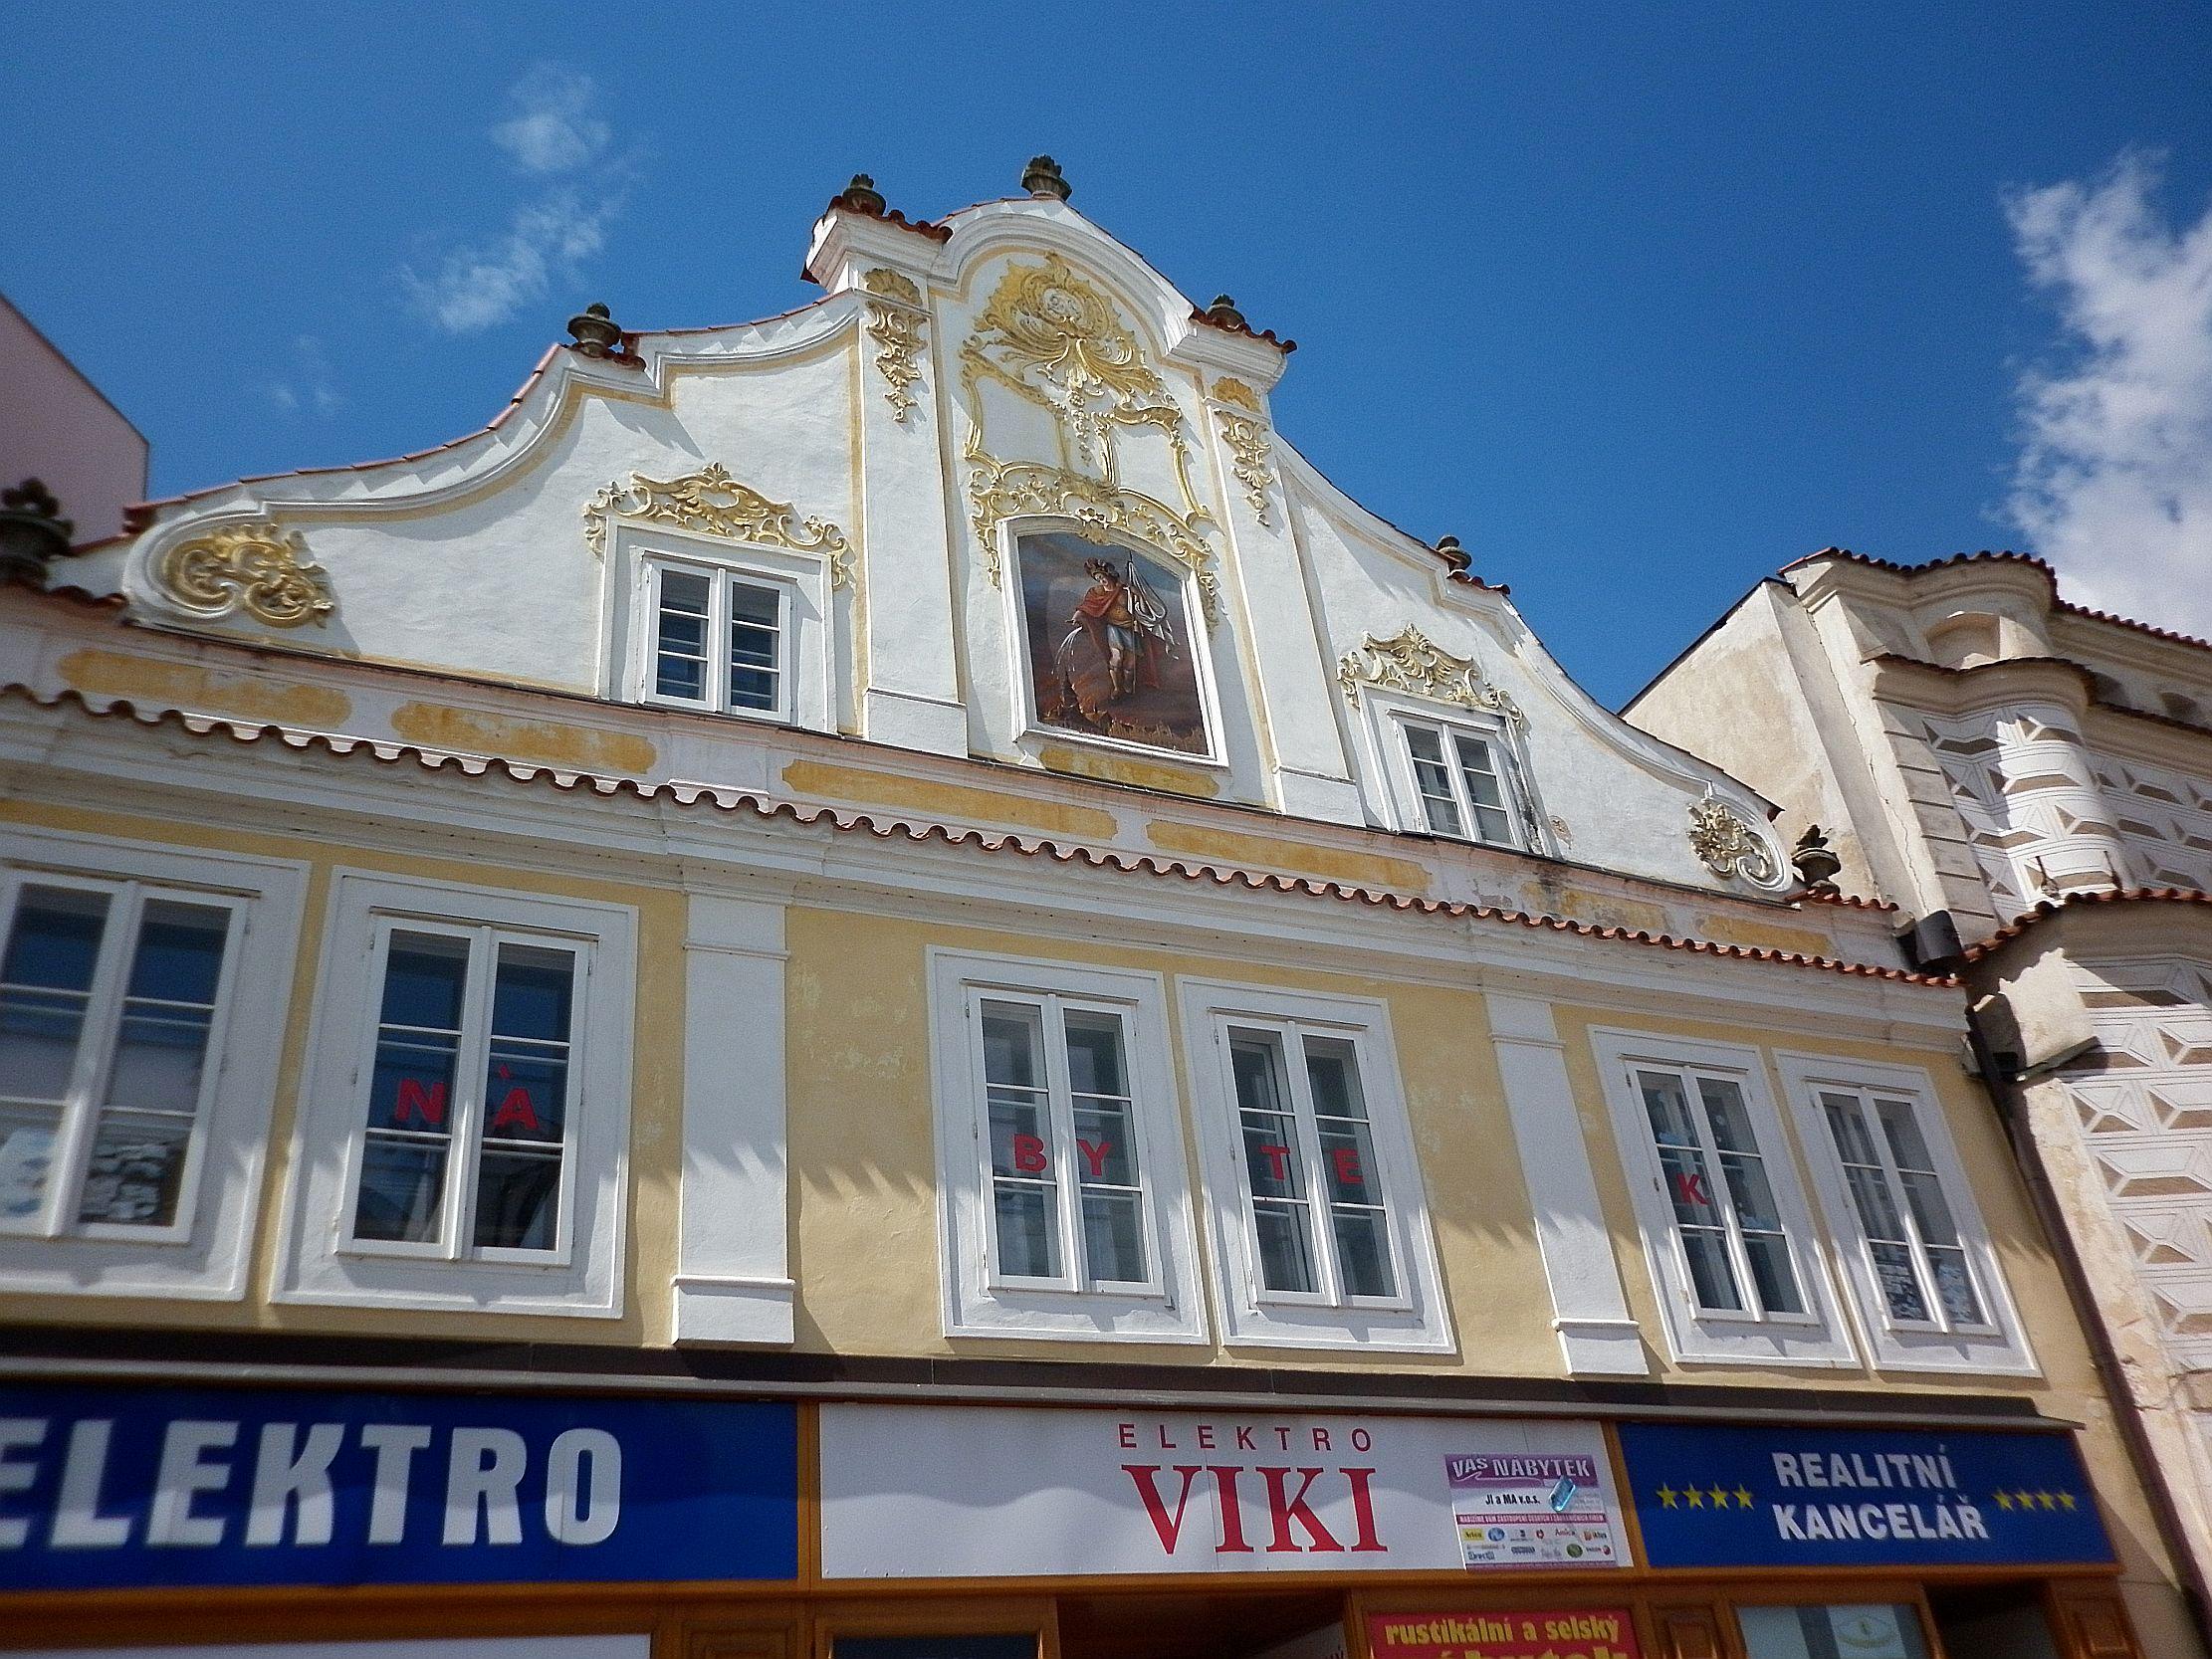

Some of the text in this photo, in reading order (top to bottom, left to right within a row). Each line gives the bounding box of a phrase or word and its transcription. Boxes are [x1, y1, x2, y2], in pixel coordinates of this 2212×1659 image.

[1118, 1422, 1373, 1453] ELEKTRO
[1492, 1455, 1591, 1477] NÁBYTEK
[1771, 1443, 1957, 1490] REALITNÍ
[1120, 1464, 1389, 1555] VIKI
[1771, 1494, 1990, 1541] KANCELÁŘ
[1385, 1614, 1620, 1645] rustikální a selský
